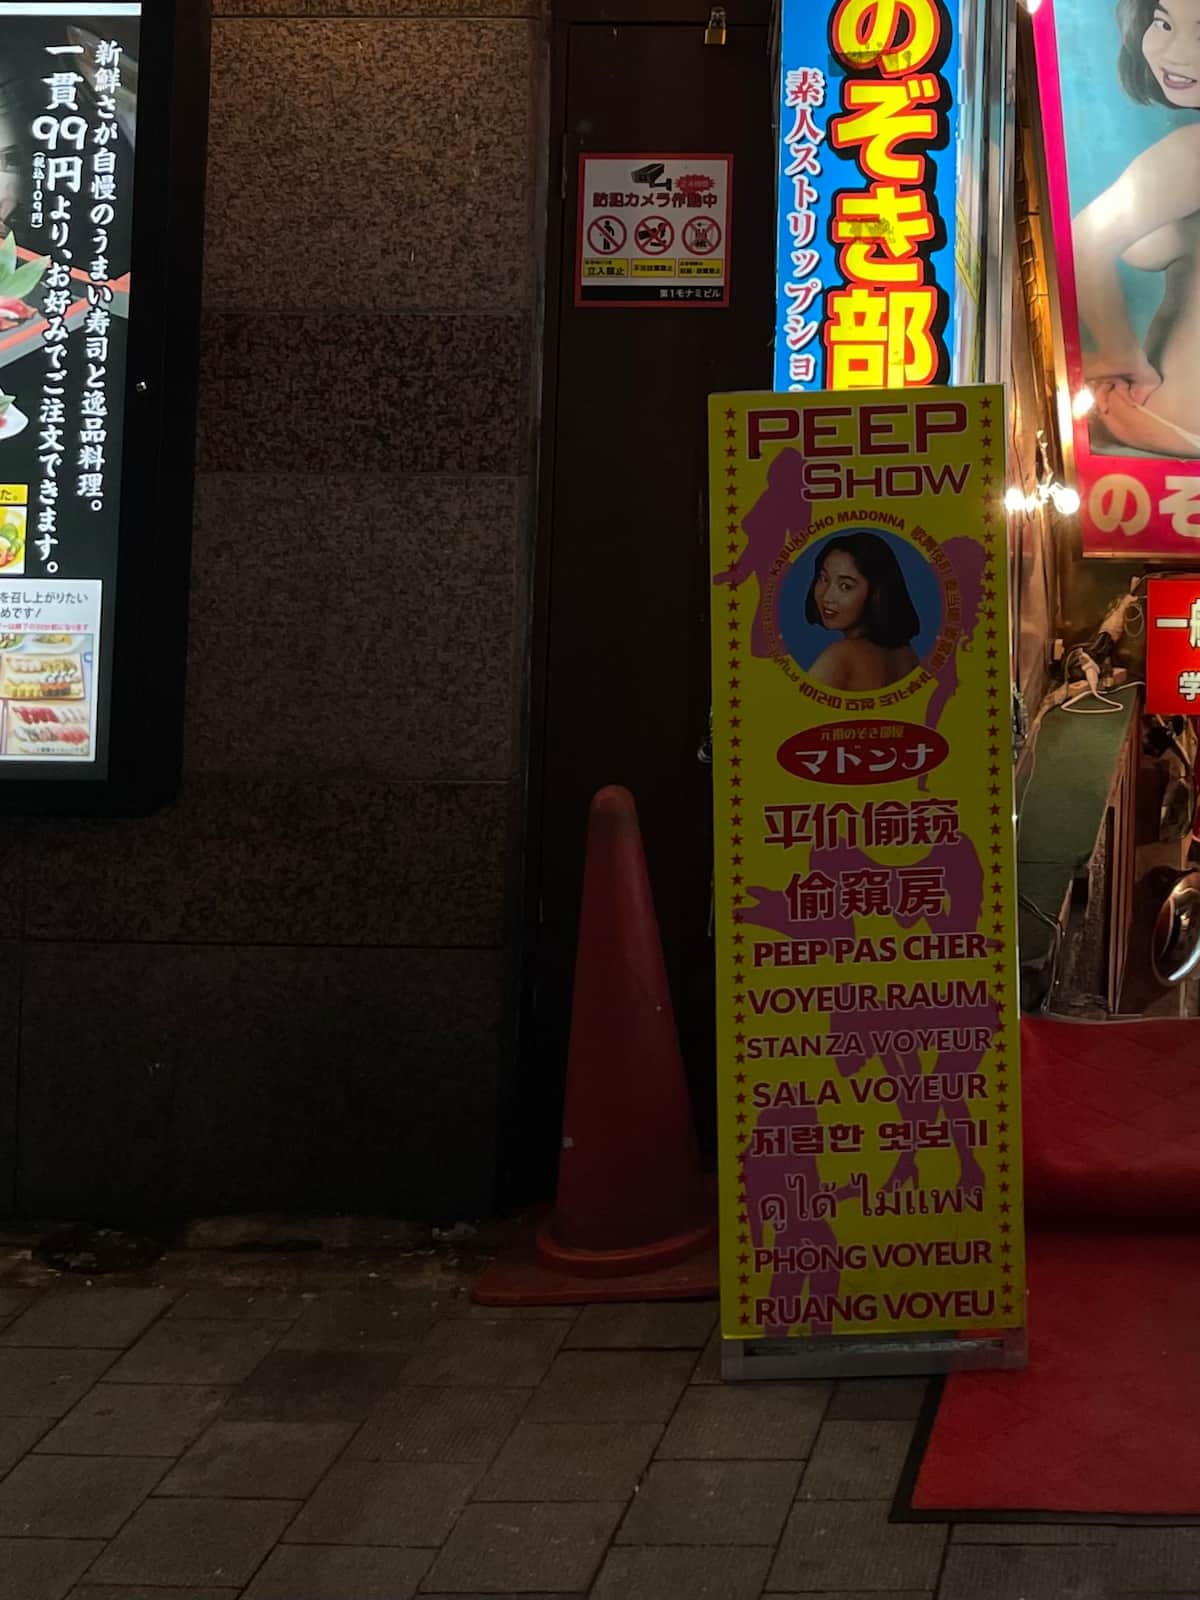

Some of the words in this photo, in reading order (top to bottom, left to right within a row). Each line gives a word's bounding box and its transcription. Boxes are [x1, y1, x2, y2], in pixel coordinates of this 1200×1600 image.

[593, 192, 717, 209] 防犯カメラ作動中
[785, 69, 825, 391] 素人ストリップショ
[77, 39, 123, 512] 新鮮さが自慢のうまい寿司と逸品料理。
[746, 401, 968, 461] PEEP
[802, 462, 971, 501] SHOW
[837, 510, 906, 531] MADONNA
[820, 726, 906, 742] 元祖のぞき部屋
[763, 798, 961, 852] 平价偷窥
[752, 938, 829, 968] PEEP
[834, 935, 898, 965] PAS
[902, 933, 989, 962] CHER
[747, 984, 880, 1017] VOYEUR
[886, 980, 989, 1010] RAUM
[746, 1033, 865, 1060] STANZA
[871, 1027, 993, 1055] VOYEUR
[752, 1079, 842, 1109] SALA
[849, 1073, 989, 1103] VOYEUR
[751, 1122, 865, 1158] 저렴한
[877, 1118, 989, 1154] 엿보기
[871, 1240, 993, 1269] VOYEUR
[753, 1296, 880, 1328] RUANG
[884, 1289, 996, 1322] VOYEU
